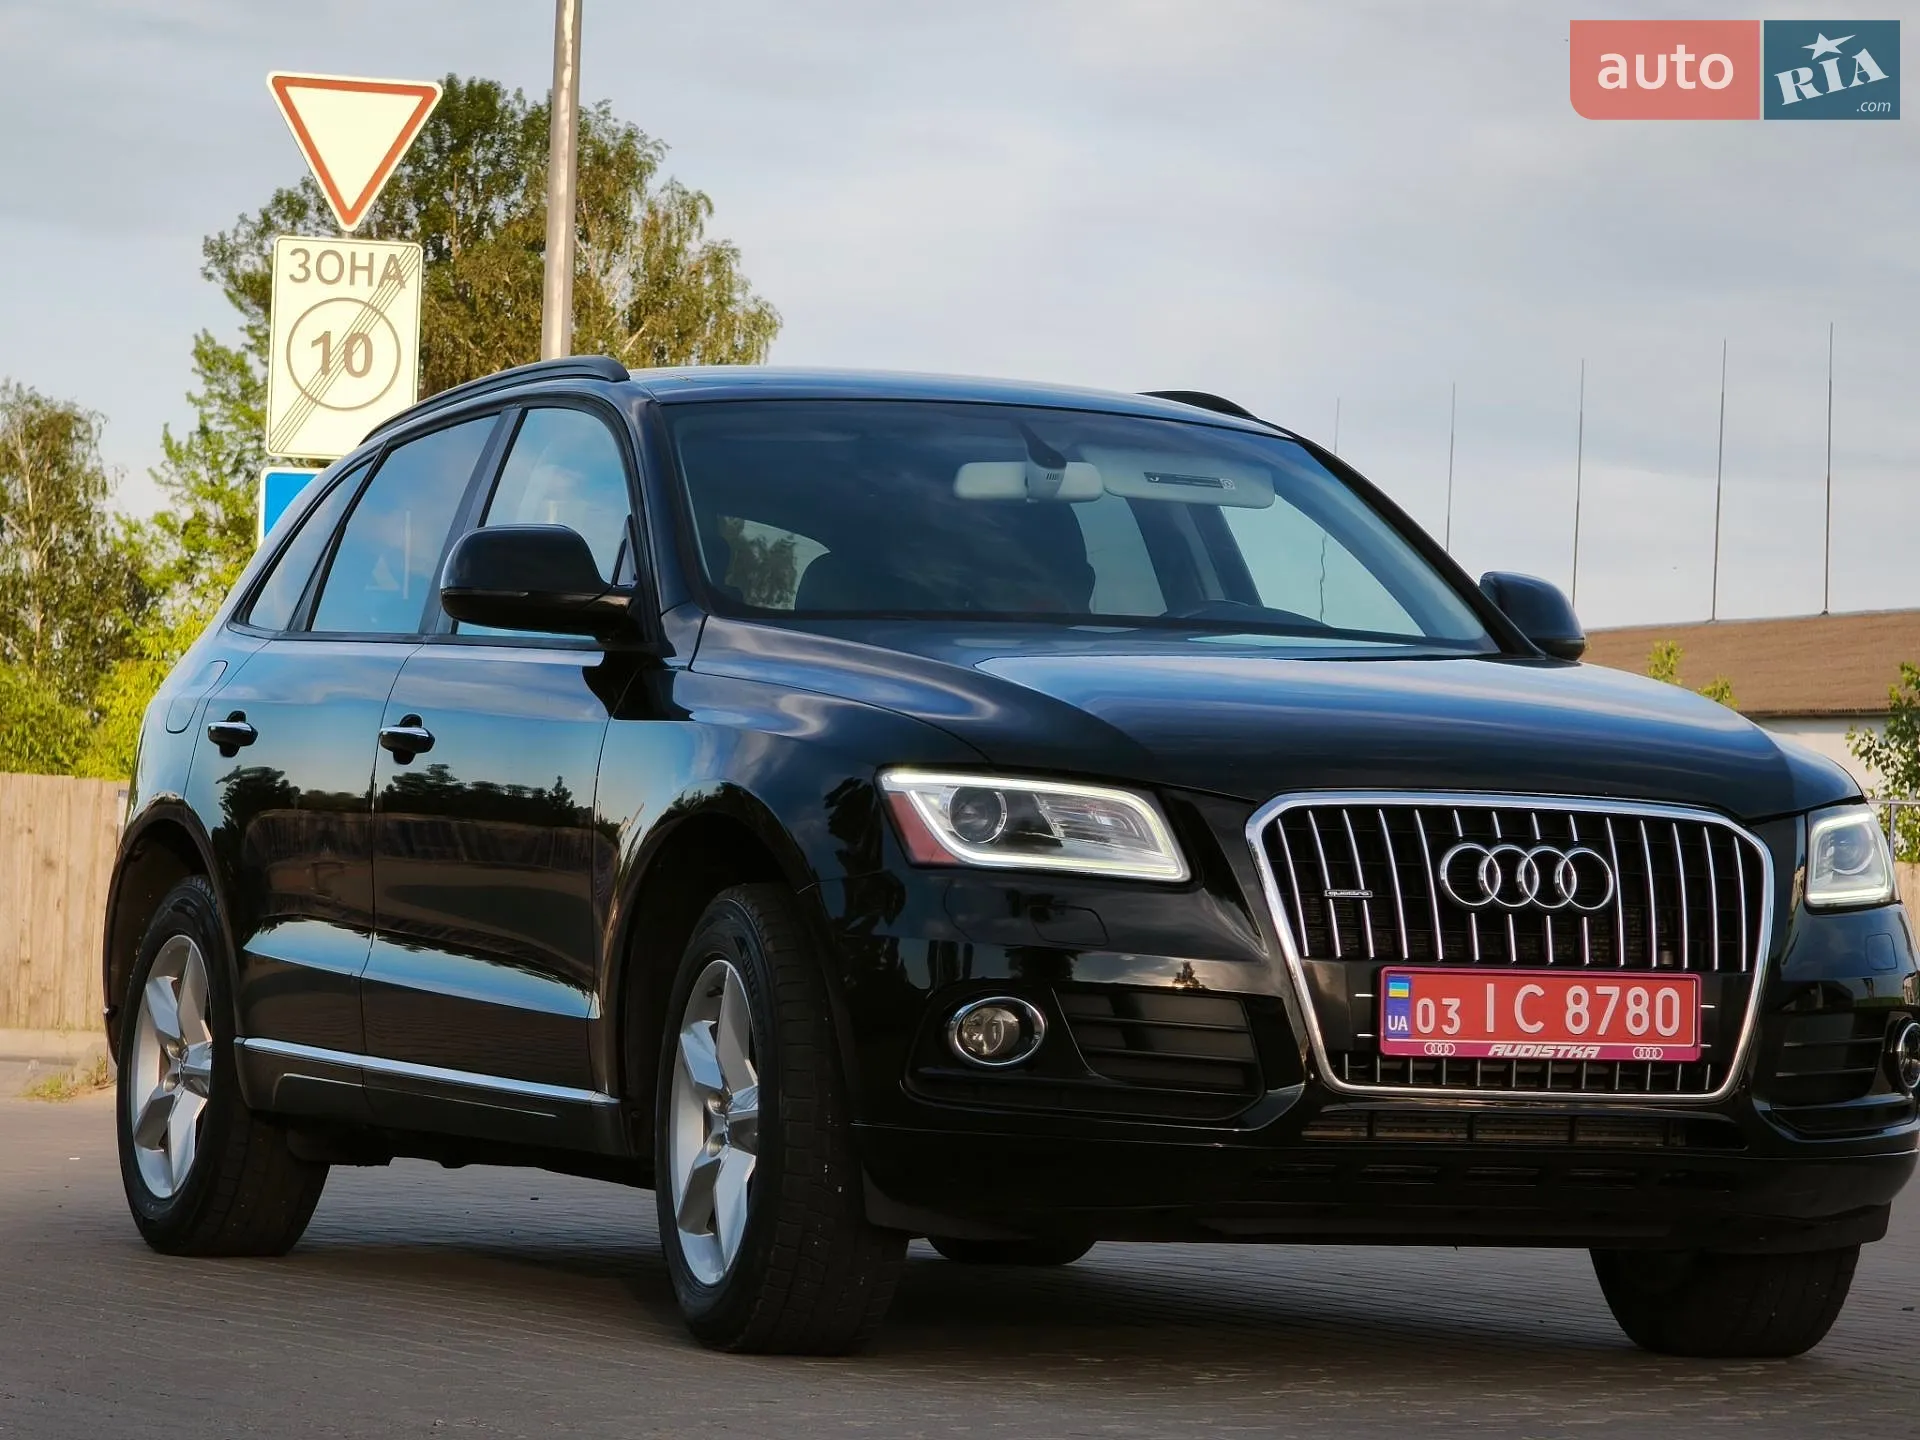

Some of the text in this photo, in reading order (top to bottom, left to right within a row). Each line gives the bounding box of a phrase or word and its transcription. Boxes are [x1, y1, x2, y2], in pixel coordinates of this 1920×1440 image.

[289, 247, 406, 289] ЗОНА
[311, 330, 373, 378] 10
[1387, 1015, 1408, 1032] UA
[1416, 997, 1461, 1035] 03
[1565, 985, 1680, 1037] 8780
[1488, 1043, 1601, 1060] AUDISTKA
